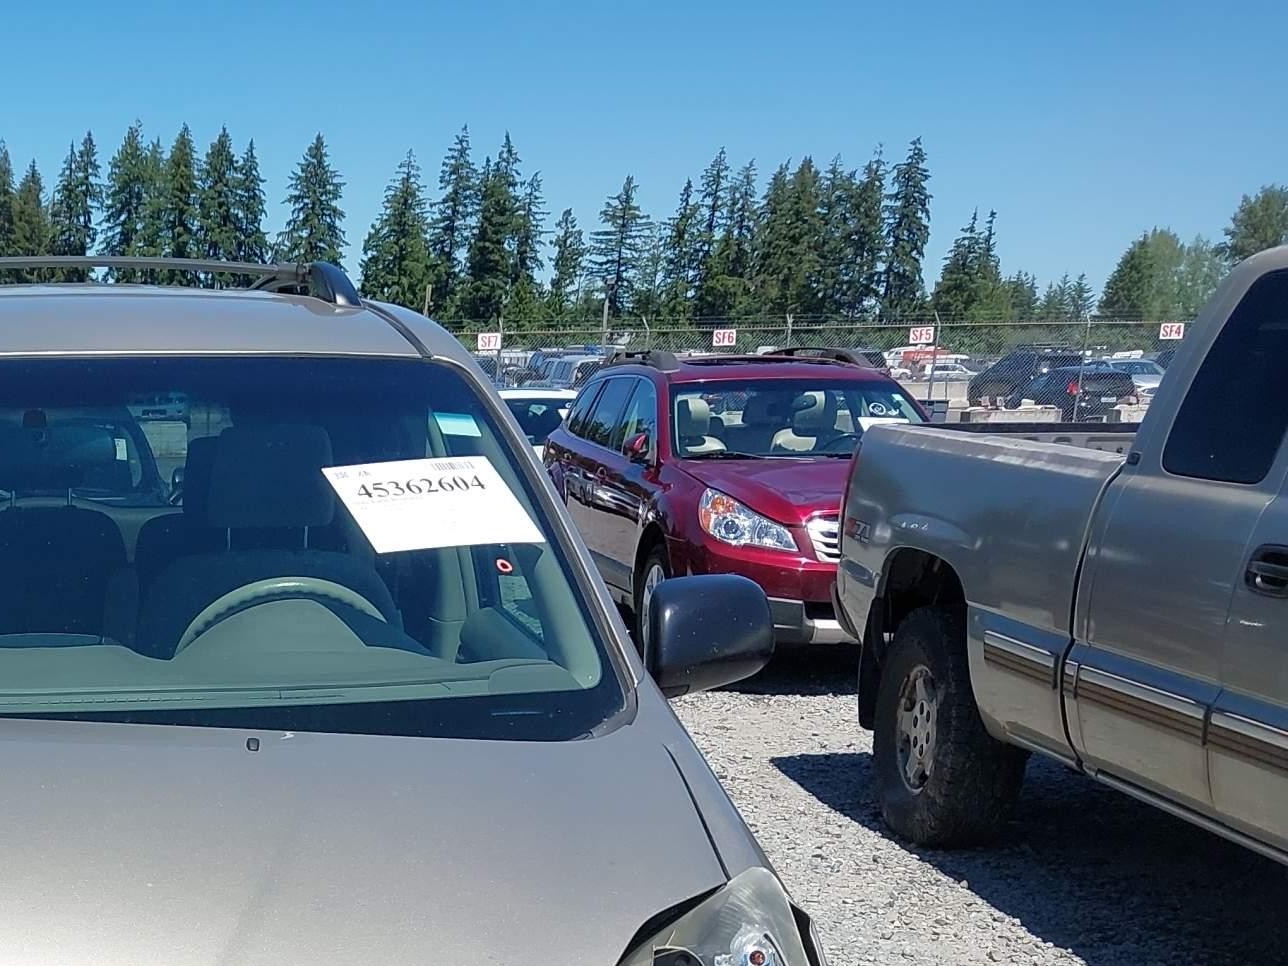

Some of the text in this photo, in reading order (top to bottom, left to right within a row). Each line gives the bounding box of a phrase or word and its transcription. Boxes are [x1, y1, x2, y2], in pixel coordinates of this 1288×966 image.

[715, 331, 734, 344] SF6
[911, 329, 932, 341] SF5
[1161, 325, 1182, 337] SF4
[481, 335, 498, 348] SF7
[357, 474, 486, 498] 45362604
